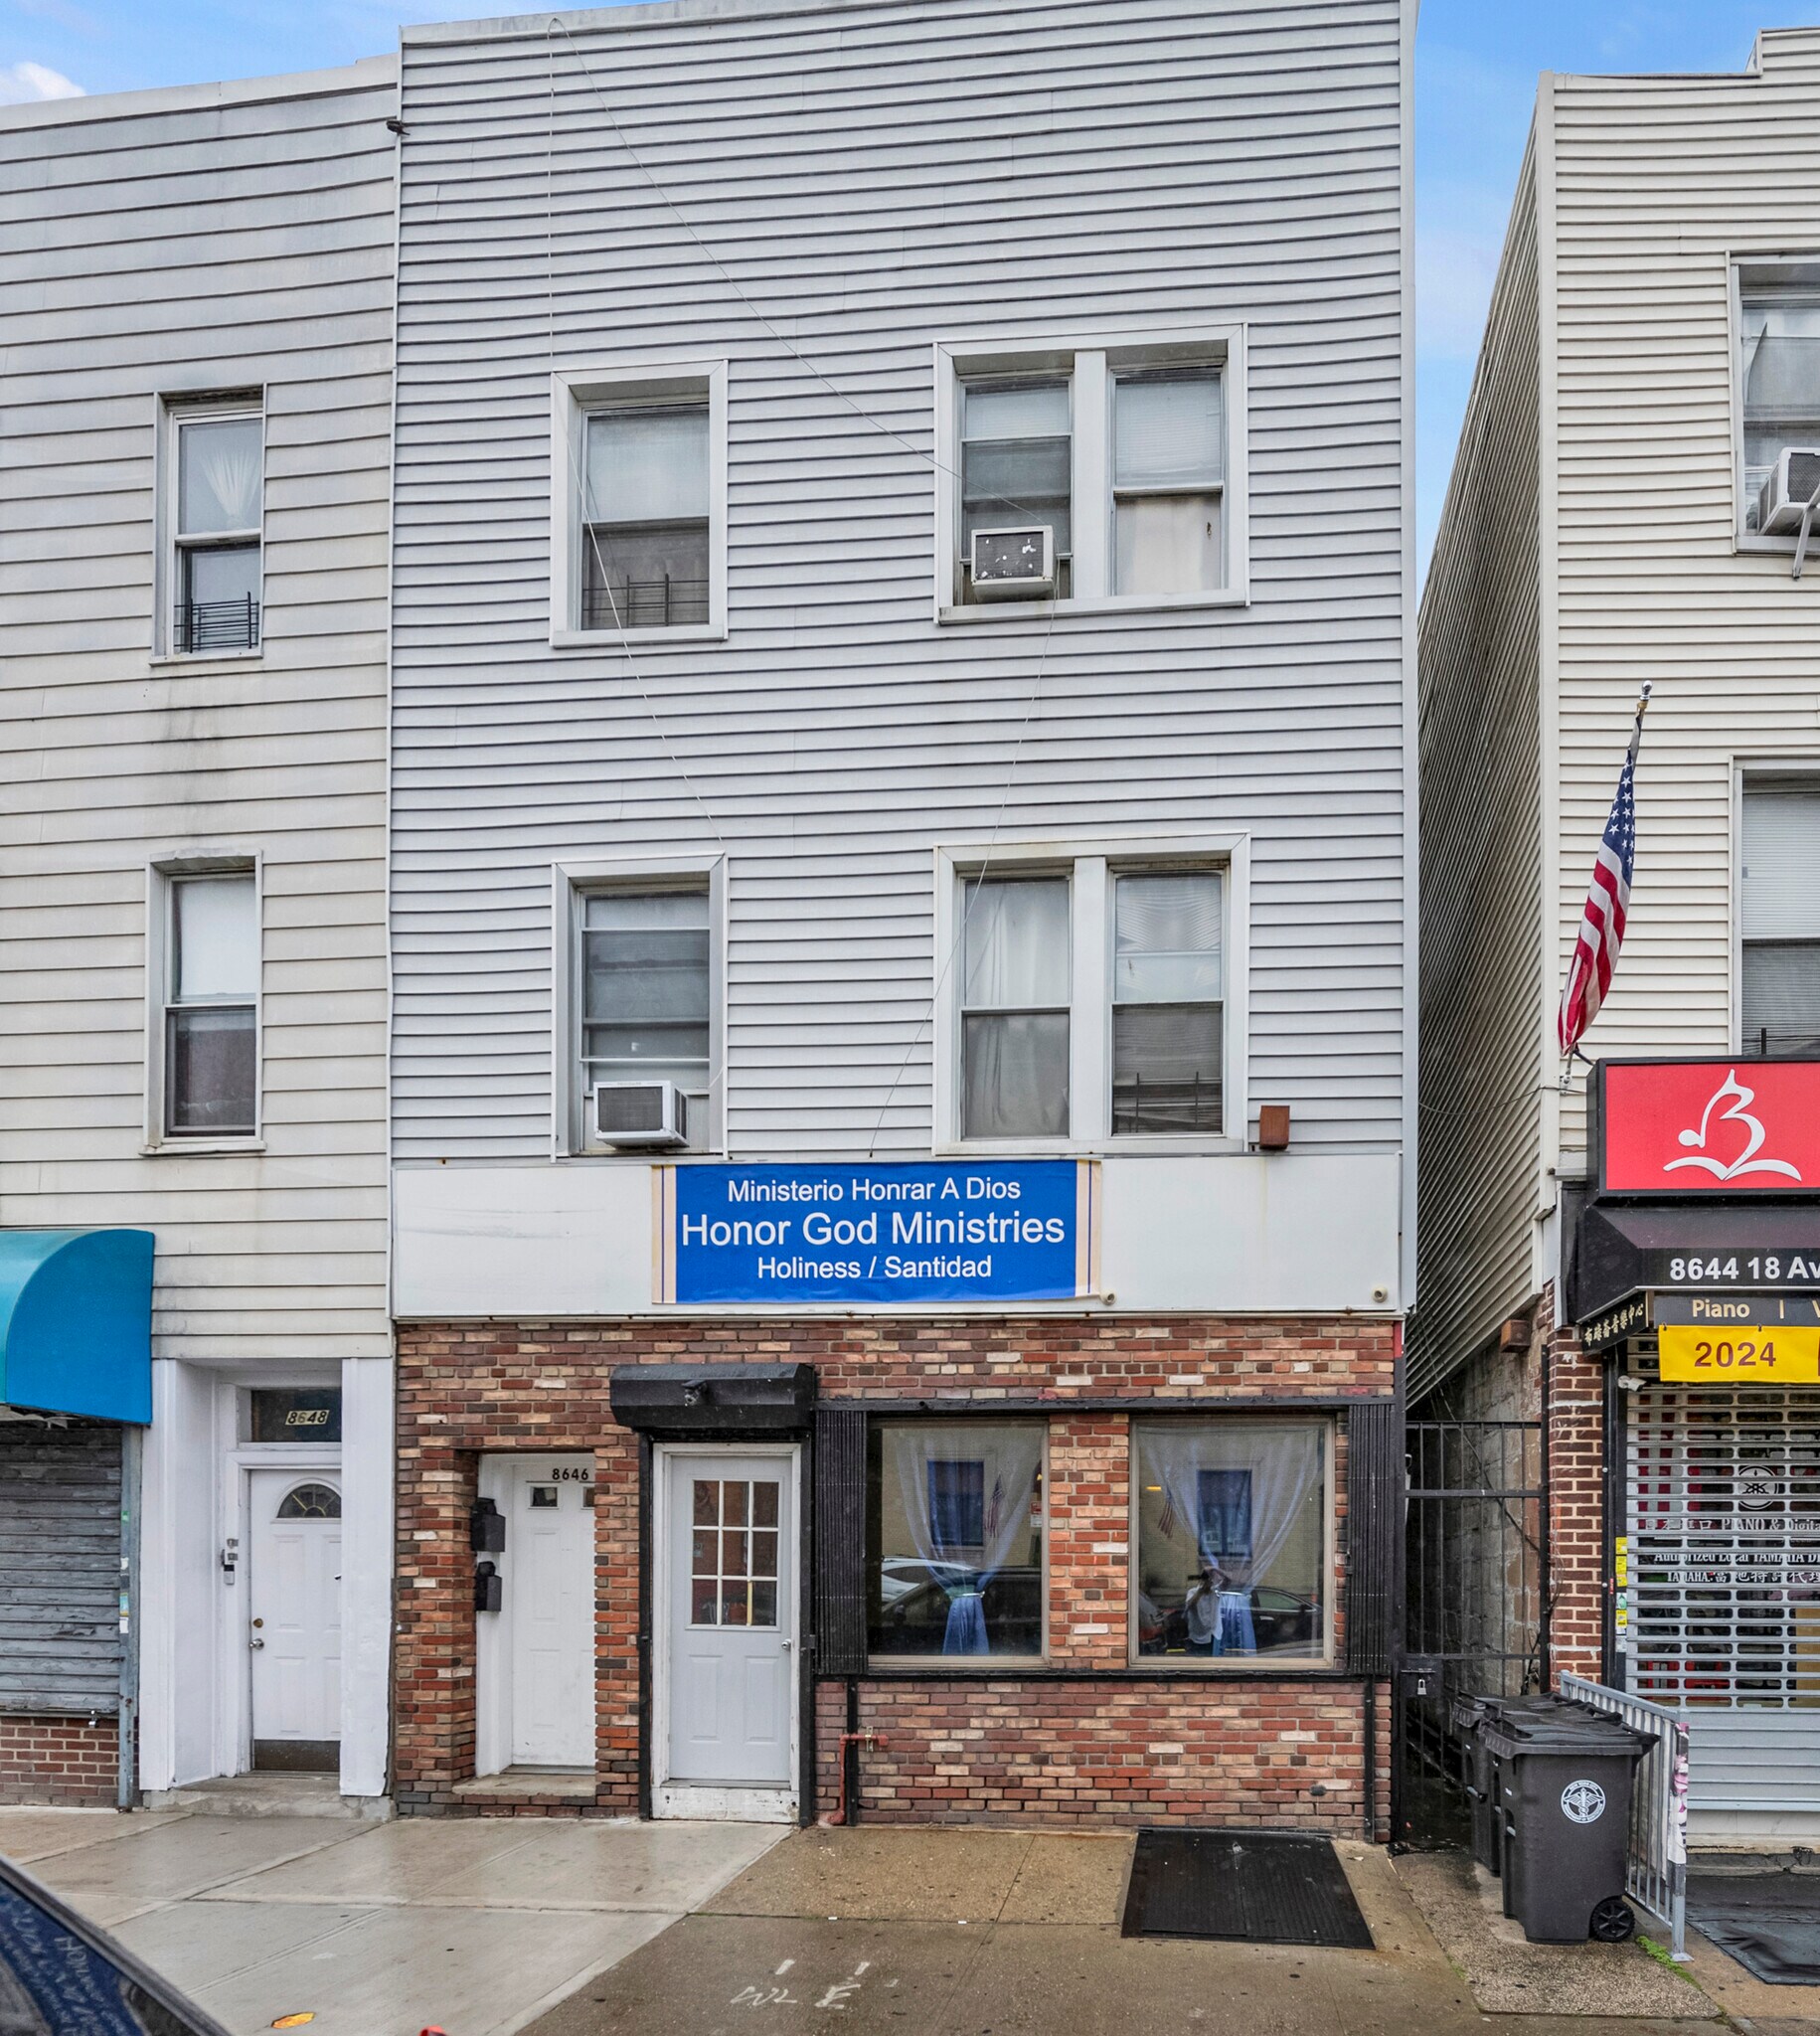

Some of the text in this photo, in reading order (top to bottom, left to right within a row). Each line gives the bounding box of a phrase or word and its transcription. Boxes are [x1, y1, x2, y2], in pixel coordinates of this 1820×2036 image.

[728, 1177, 1022, 1202] Ministerio Honrar A Dios
[682, 1210, 1066, 1246] Honor God Ministries
[757, 1255, 992, 1279] Holiness / Santidad
[1670, 1257, 1739, 1280] 8644
[1747, 1257, 1781, 1280] 18
[1692, 1298, 1750, 1318] Piano
[1694, 1341, 1777, 1368] 2024
[287, 1411, 328, 1424] 8648
[552, 1467, 588, 1480] 8646
[1768, 1518, 1780, 1531] &
